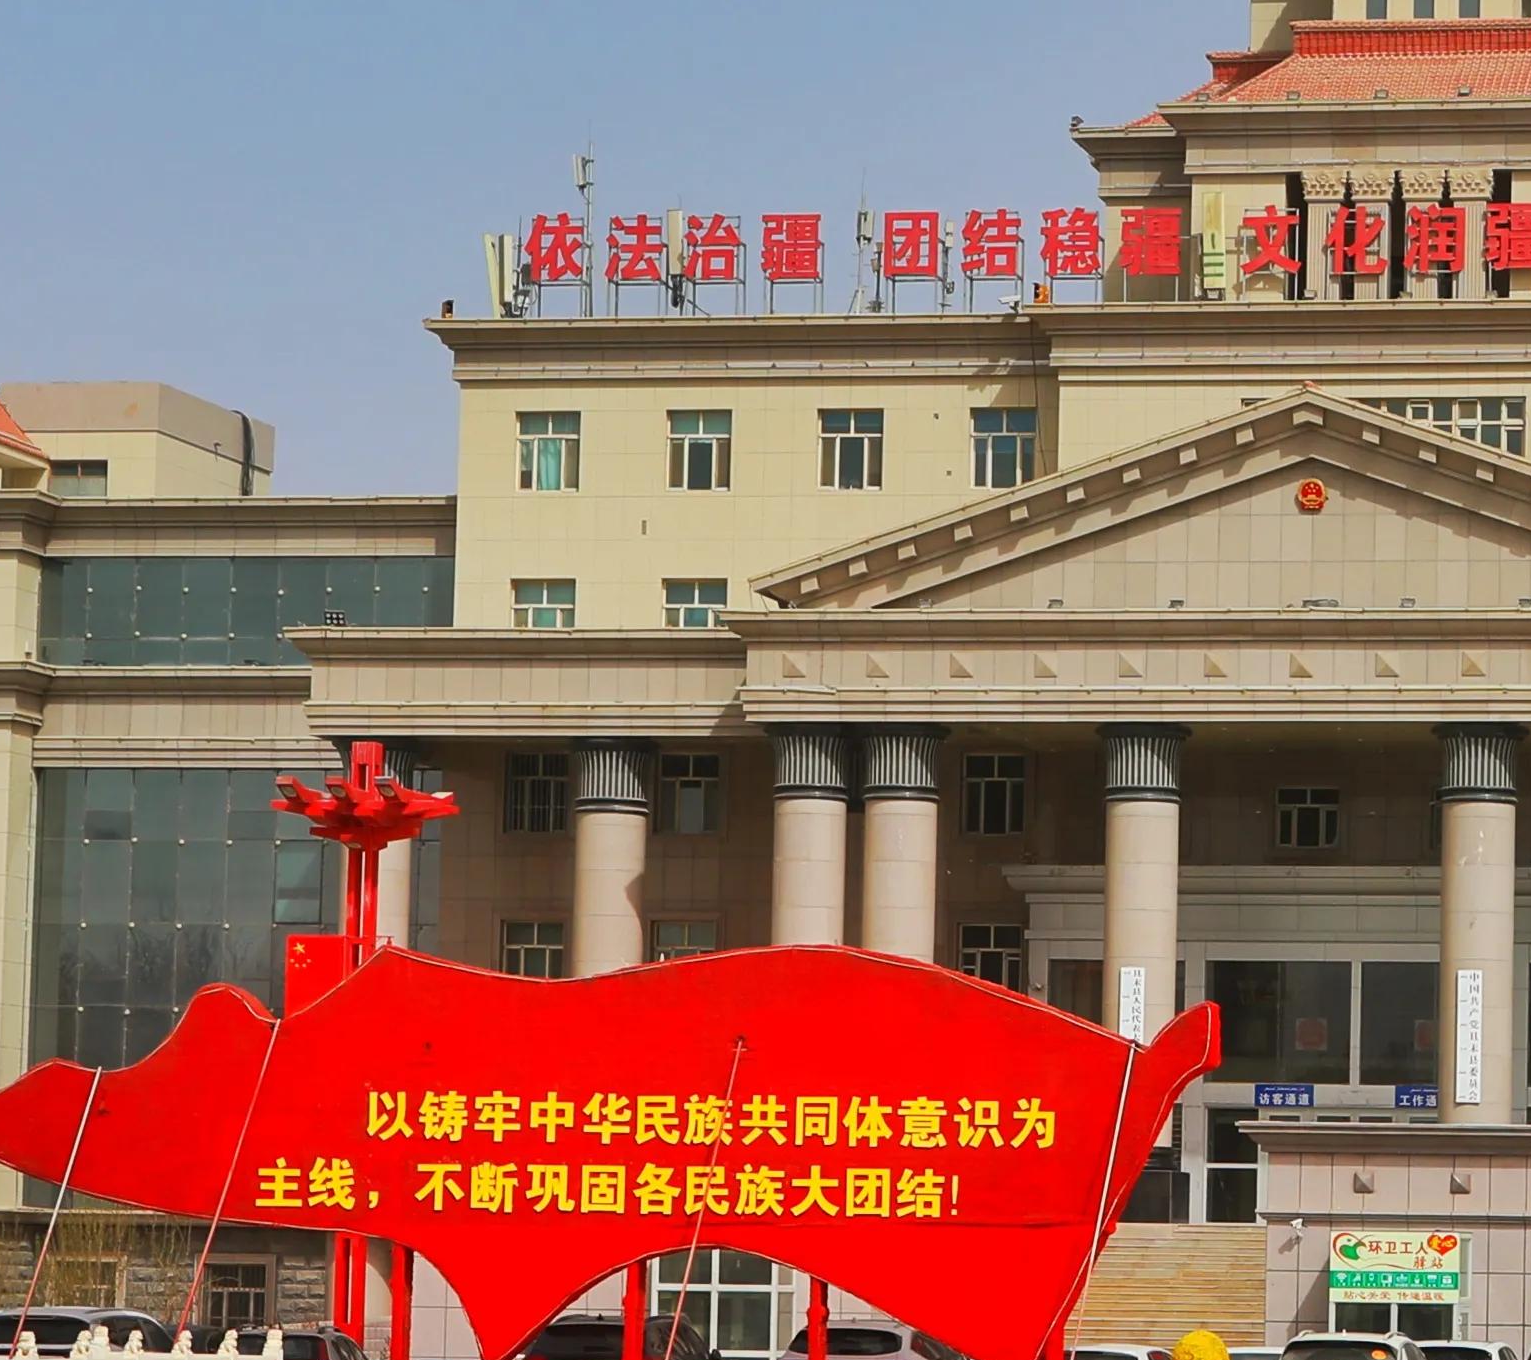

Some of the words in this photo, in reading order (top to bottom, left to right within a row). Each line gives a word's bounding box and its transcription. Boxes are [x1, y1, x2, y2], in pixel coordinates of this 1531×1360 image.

[524, 212, 821, 280] 依法治疆
[883, 205, 1183, 276] 团结稳疆
[1258, 1092, 1311, 1107] 访客通道
[366, 1089, 1057, 1150] 以铸牢中华民族共同体意识为
[1367, 1240, 1429, 1255] 环卫工人
